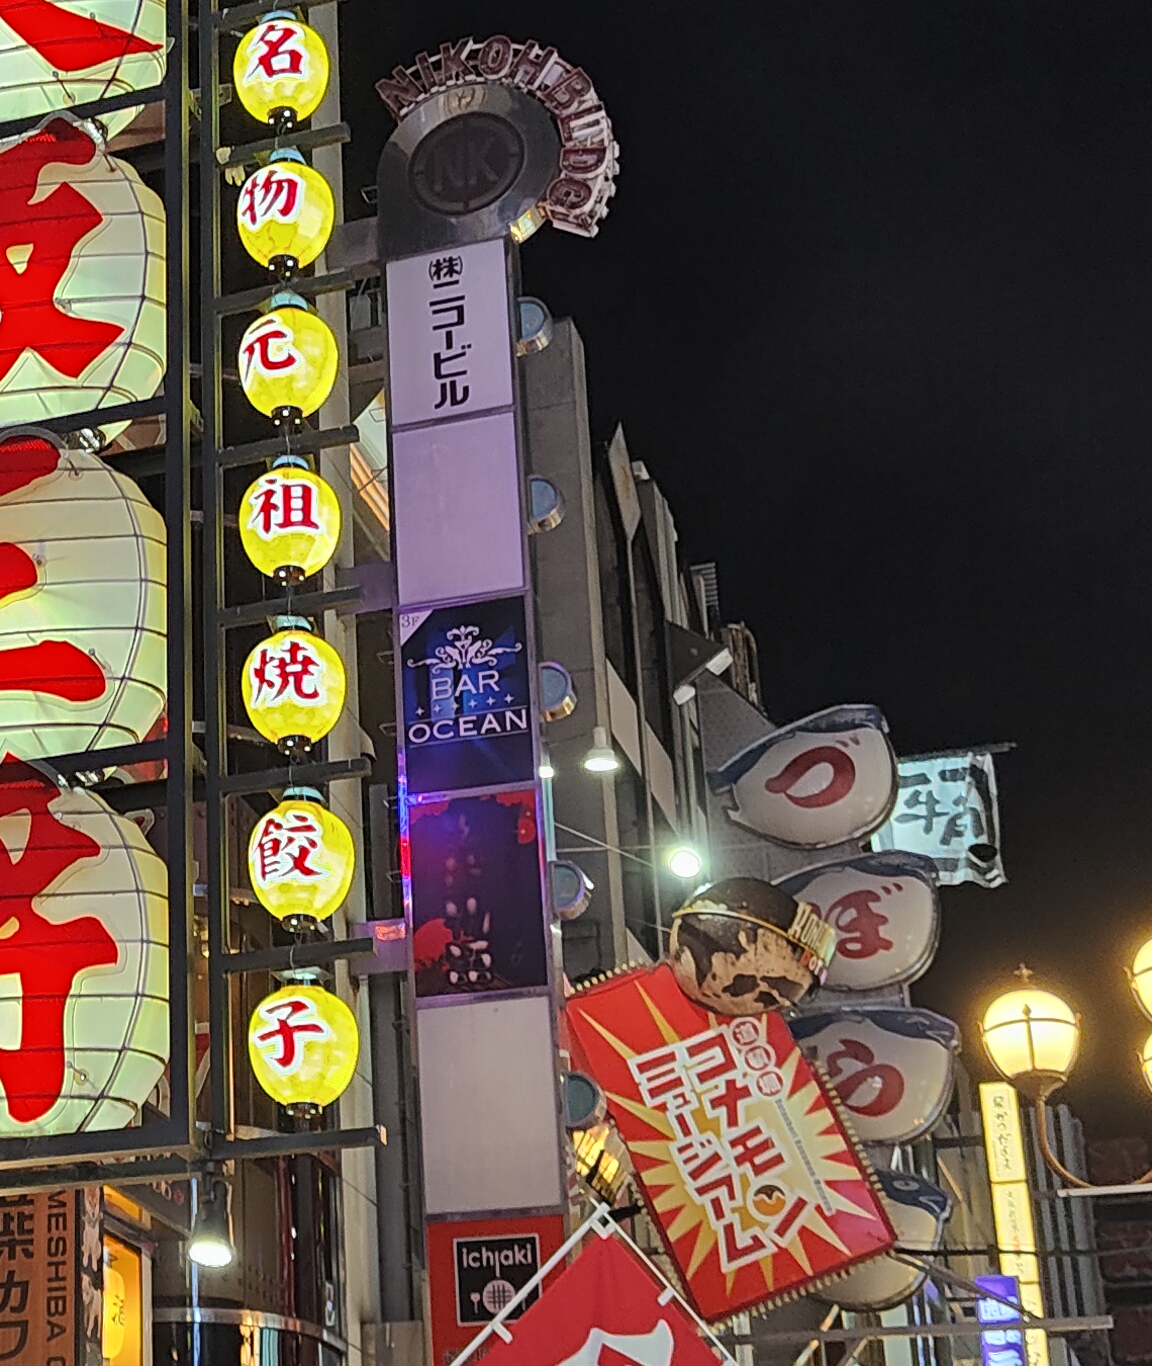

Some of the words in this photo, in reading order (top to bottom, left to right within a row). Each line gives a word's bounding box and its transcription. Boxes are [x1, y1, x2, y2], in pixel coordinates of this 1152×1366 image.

[375, 36, 559, 117] NIKOH
[401, 615, 421, 628] 3F
[430, 670, 500, 701] BAR
[407, 708, 528, 745] OCEAN
[634, 1049, 768, 1265] ミュージアム
